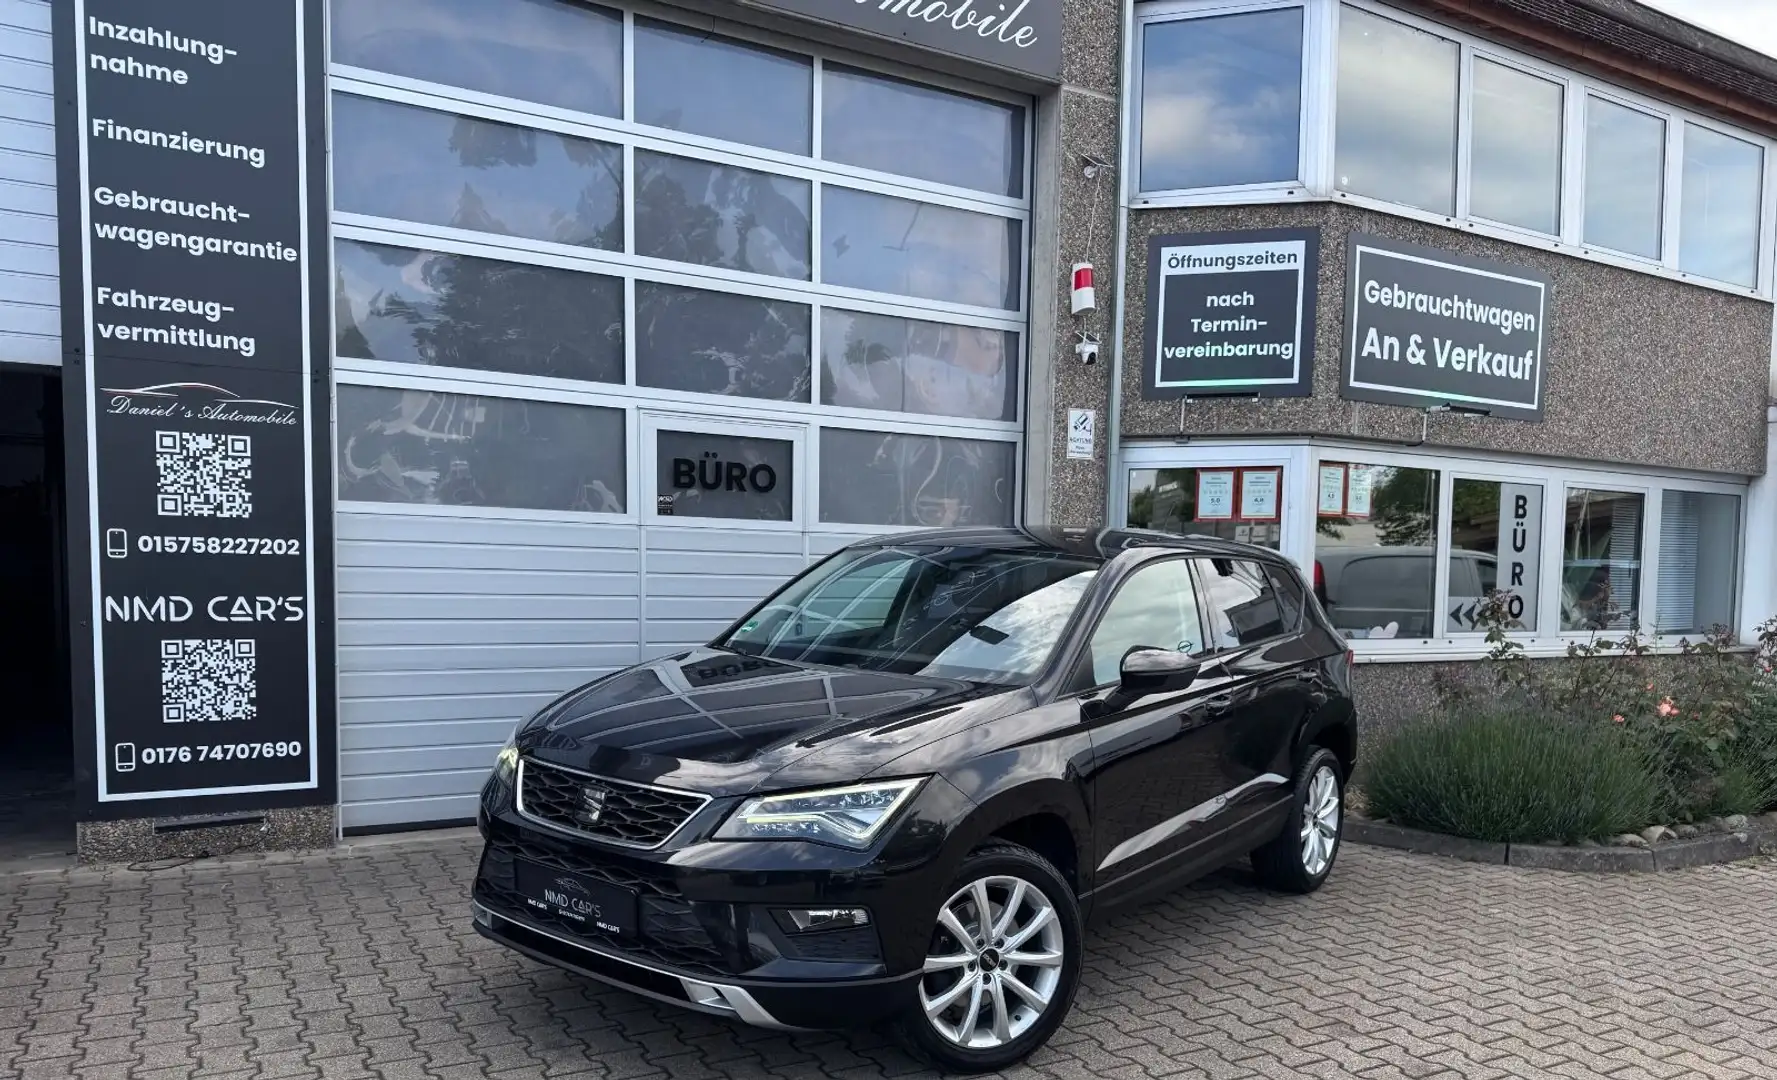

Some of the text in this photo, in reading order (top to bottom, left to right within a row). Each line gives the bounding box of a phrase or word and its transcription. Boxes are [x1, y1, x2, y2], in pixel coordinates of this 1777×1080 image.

[89, 16, 238, 65] Inzahlung-
[90, 52, 190, 85] nahme
[92, 118, 266, 169] Finanzierung
[94, 187, 251, 223] Gebraucht-
[95, 221, 298, 262] wagengarantie
[1167, 250, 1299, 271] Öffnungszeiten
[97, 286, 235, 324] Fahrzeug-
[1206, 291, 1255, 308] nach
[1364, 279, 1536, 336] Gebrauchtwagen
[97, 322, 256, 358] vermittlung
[1190, 316, 1268, 334] Termin-
[1164, 341, 1295, 360] vereinbarung
[1362, 327, 1534, 381] An & Verkauf
[198, 403, 297, 425] Automobile
[673, 451, 777, 494] BÜRO
[137, 534, 300, 556] 015758227202
[1508, 494, 1529, 620] BÜRO
[105, 595, 304, 623] NMD CAR'S
[141, 740, 302, 765] 0176 74707690
[544, 889, 569, 907] NMD
[571, 898, 601, 918] CAR'S
